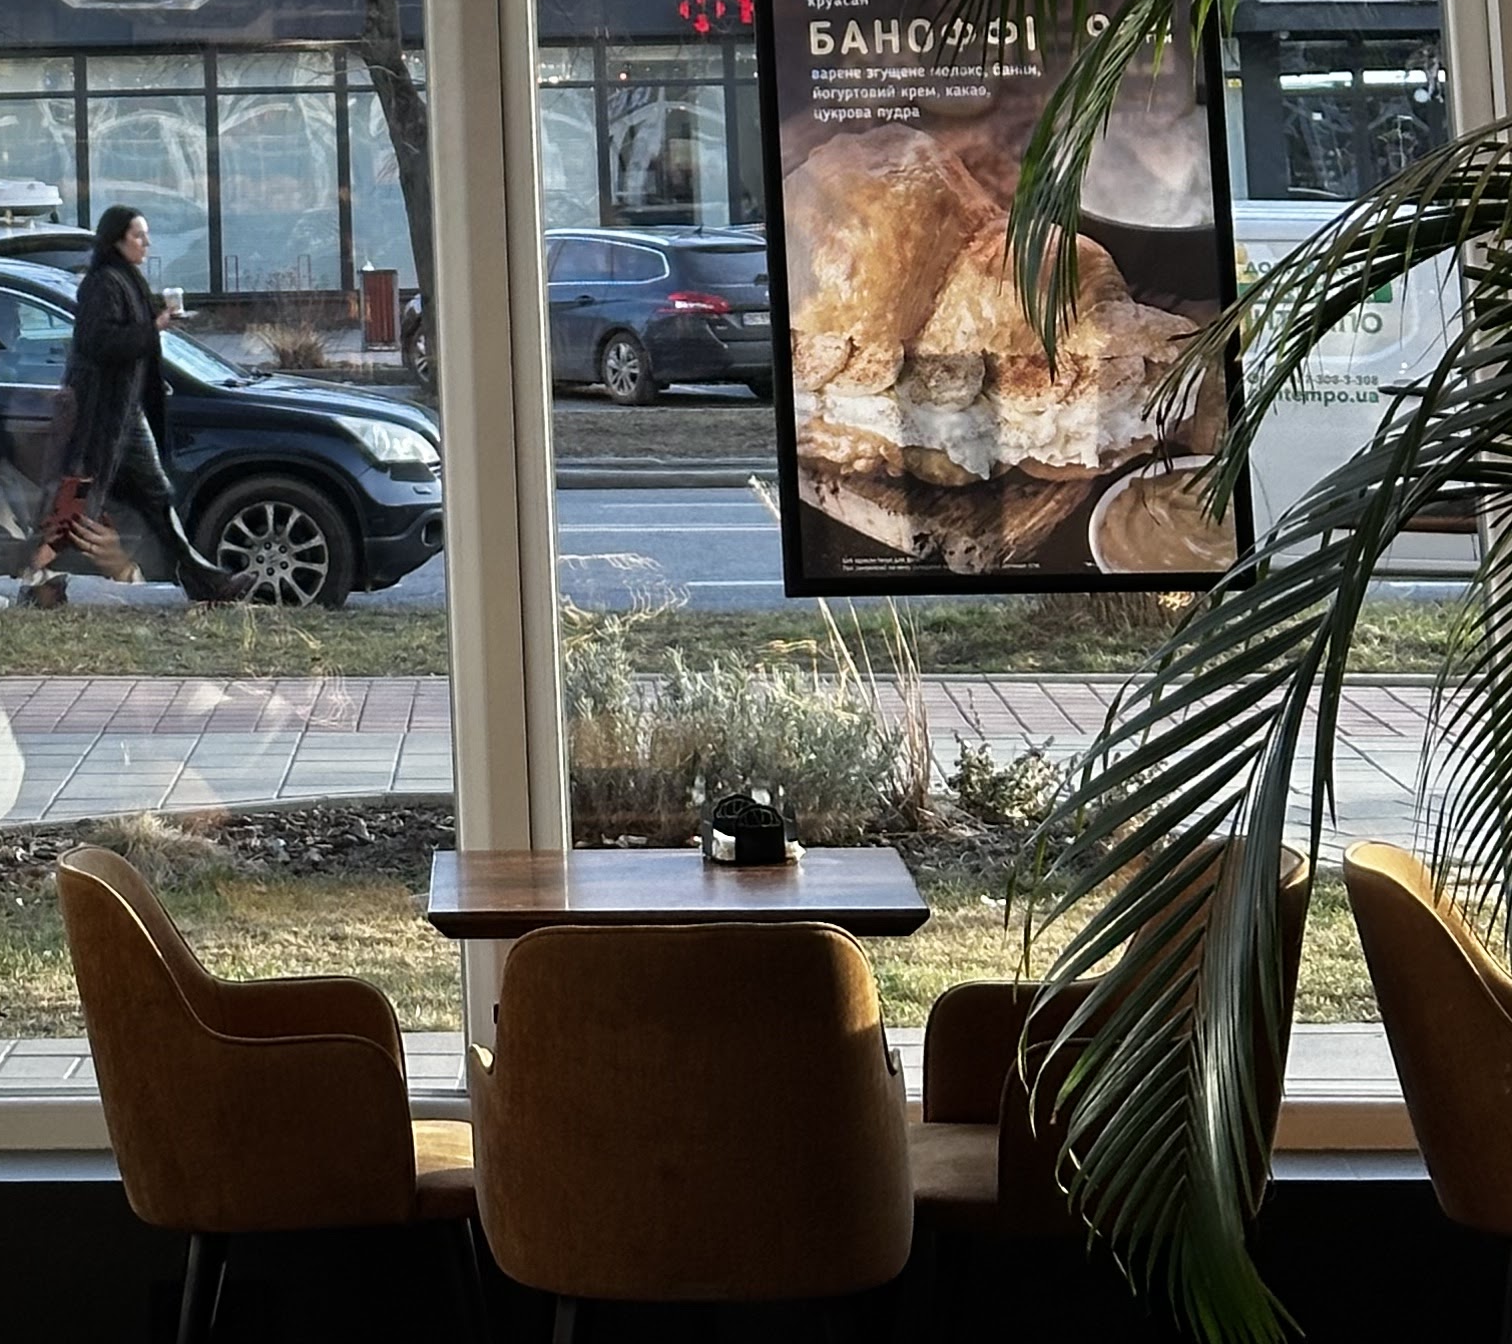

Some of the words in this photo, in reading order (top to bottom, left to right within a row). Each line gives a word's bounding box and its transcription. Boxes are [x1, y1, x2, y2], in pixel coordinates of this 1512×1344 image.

[811, 68, 861, 81] варене
[866, 68, 925, 81] згущене
[813, 86, 895, 100] йогуртовий
[901, 87, 940, 100] крем,
[946, 86, 991, 97] какао,
[813, 108, 871, 122] цукрова
[877, 107, 920, 119] пудра
